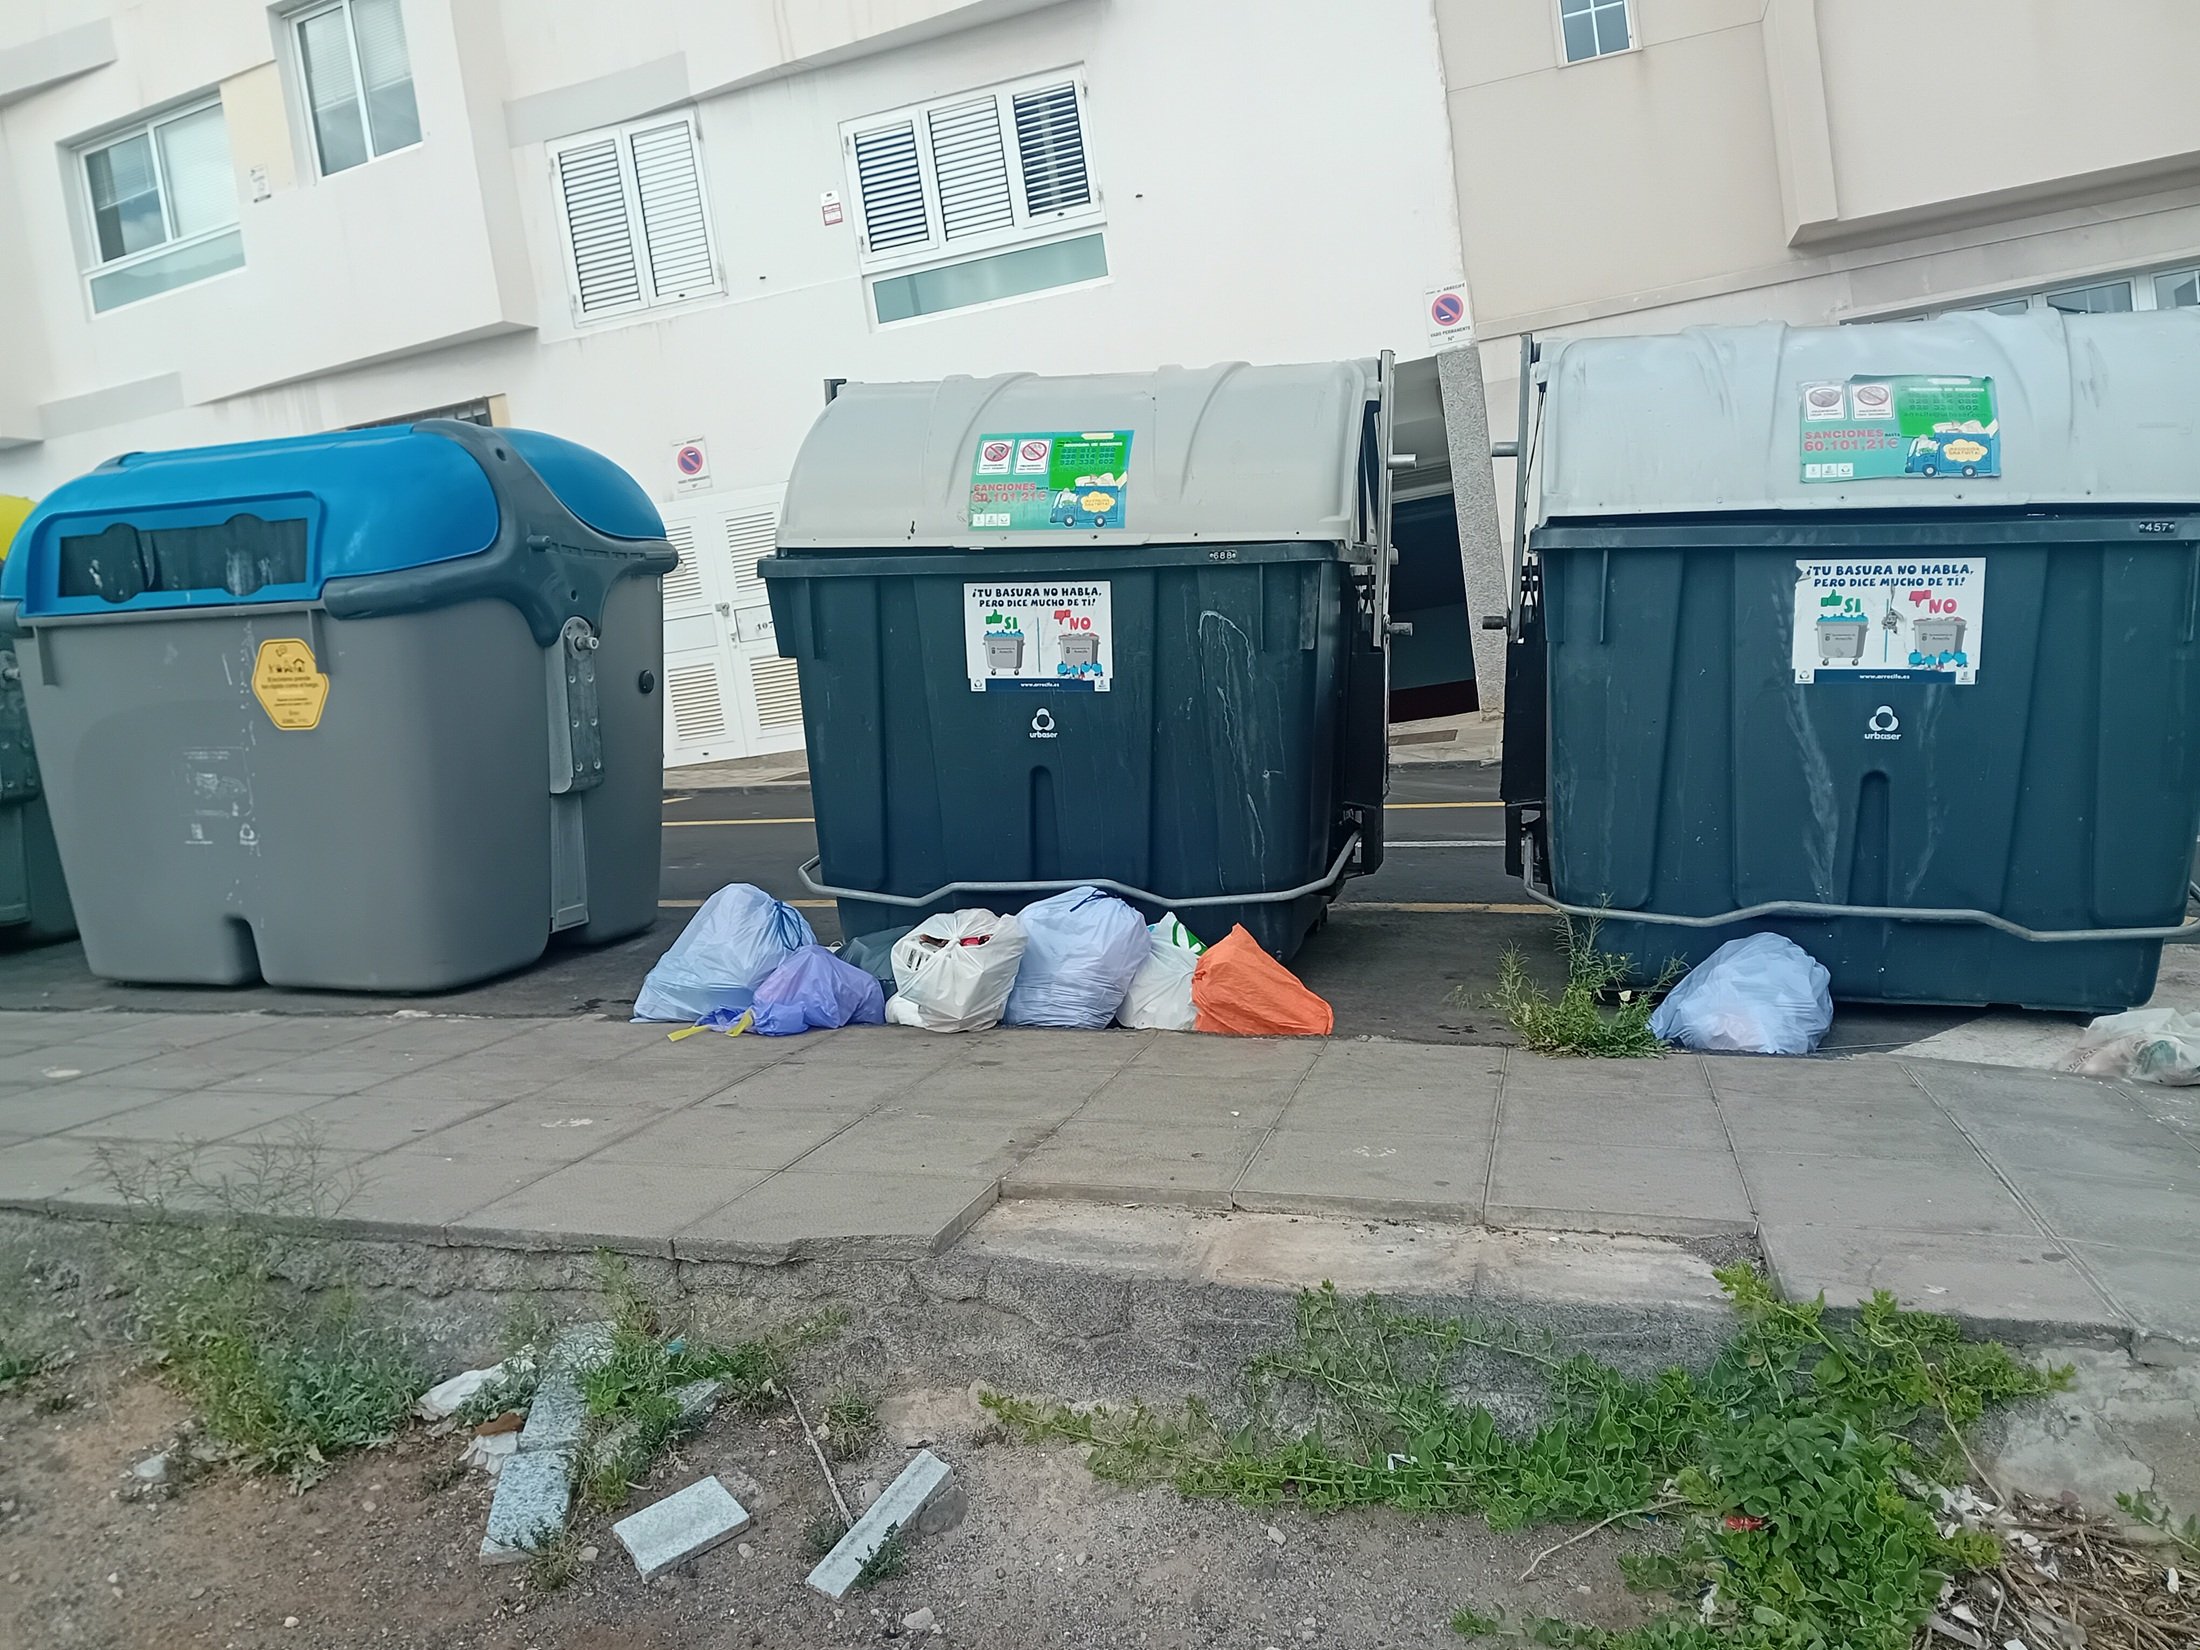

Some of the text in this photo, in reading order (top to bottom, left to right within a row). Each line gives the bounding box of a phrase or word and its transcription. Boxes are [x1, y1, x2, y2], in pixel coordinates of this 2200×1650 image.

[1804, 429, 1883, 439] SANCIONES
[1803, 439, 1899, 451] 60.101,21€
[974, 483, 1036, 491] SANCIONES
[2145, 523, 2169, 531] 457
[1806, 564, 1974, 575] ¡TU BASURA NO HABLA,
[1814, 579, 1846, 587] PERO
[1849, 579, 1876, 587] DICE
[1880, 578, 1924, 586] MUCHO
[1928, 578, 1943, 586] DE
[972, 587, 1102, 597] ¡TU BASURA NO HABLA,
[1844, 598, 1861, 613] SI
[1929, 599, 1957, 614] NO
[1004, 617, 1018, 630] SI
[1069, 617, 1091, 630] NO
[1864, 731, 1901, 740] urbaser
